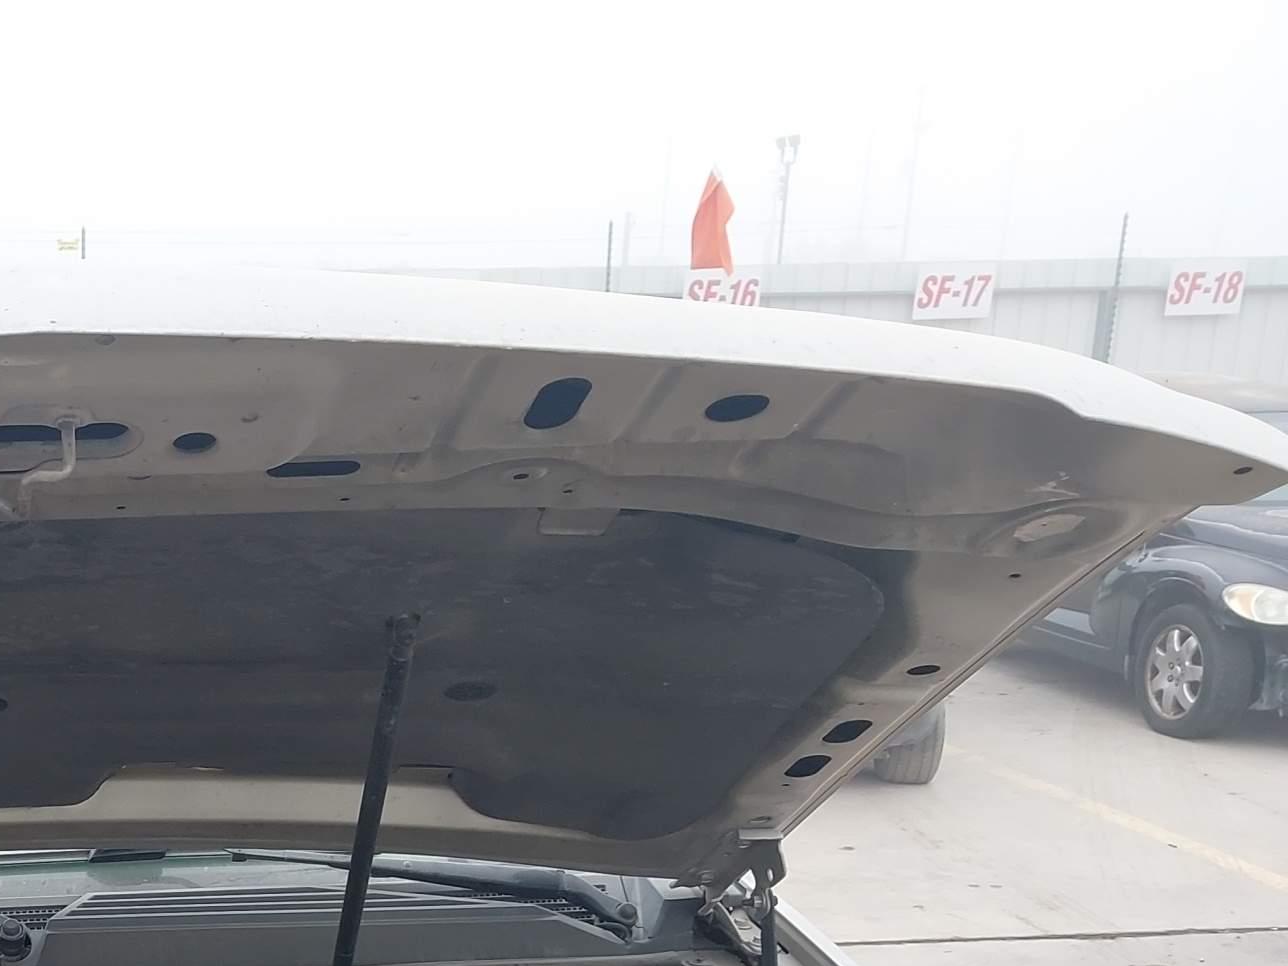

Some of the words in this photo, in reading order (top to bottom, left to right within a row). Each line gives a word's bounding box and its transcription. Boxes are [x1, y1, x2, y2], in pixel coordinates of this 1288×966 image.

[688, 279, 759, 306] SF-16
[917, 274, 992, 309] SF-17
[1168, 271, 1243, 305] SF-18
